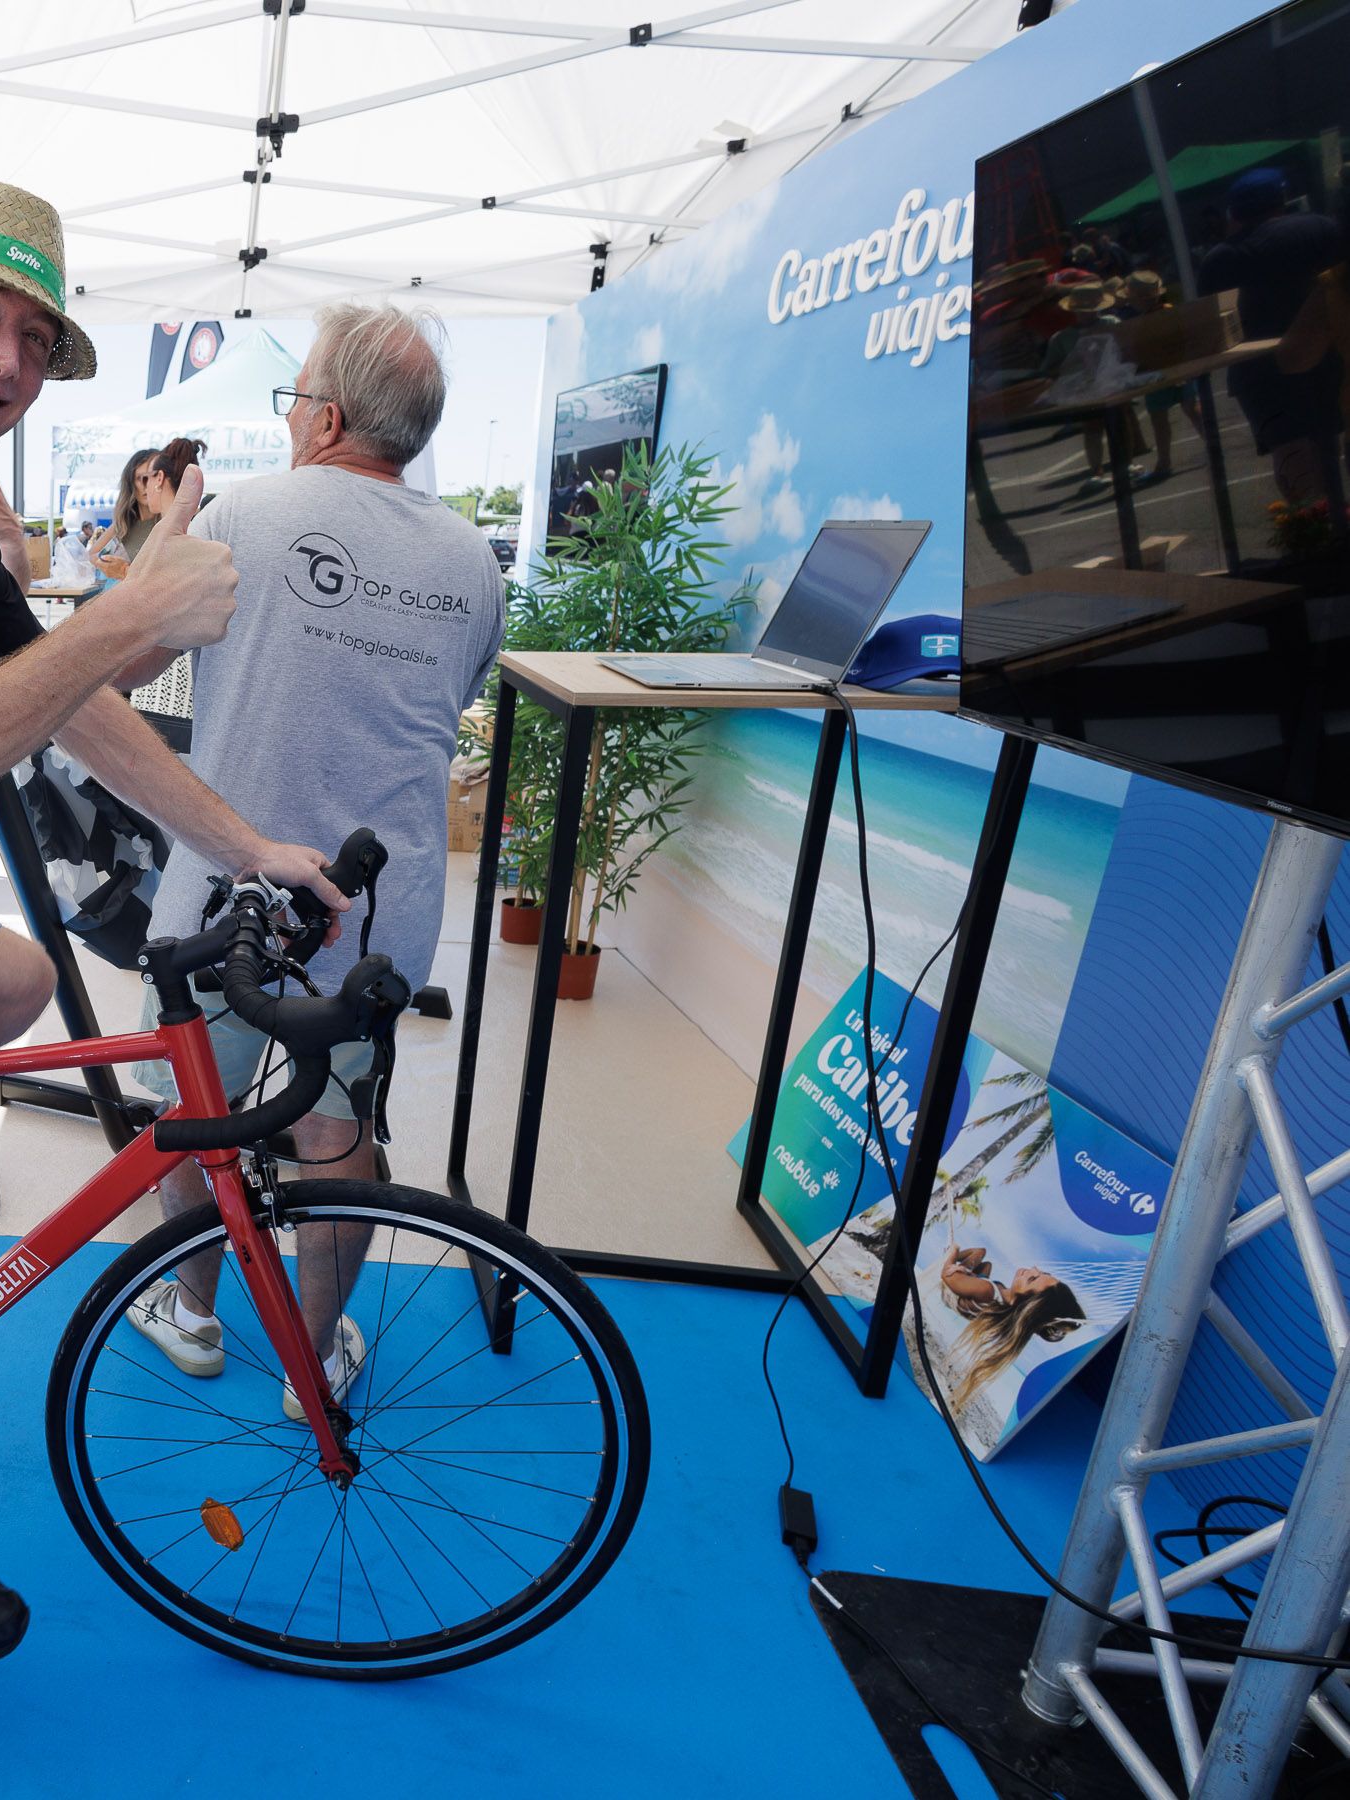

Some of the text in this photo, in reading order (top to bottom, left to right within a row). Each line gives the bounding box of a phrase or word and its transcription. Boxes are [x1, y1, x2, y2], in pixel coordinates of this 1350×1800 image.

[6, 246, 41, 270] Sprite
[206, 457, 254, 470] SPRITZ
[351, 574, 471, 614] TOP GLOBAL
[361, 598, 392, 612] CREATIVE
[397, 608, 414, 617] EASY
[303, 624, 438, 666] www.topglobalsl.es
[1266, 800, 1293, 812] Hisense
[793, 1073, 824, 1103] para
[820, 1095, 844, 1121] dos
[773, 1145, 821, 1198] newblue
[1074, 1151, 1130, 1195] Carrefour
[1093, 1182, 1121, 1205] viajes
